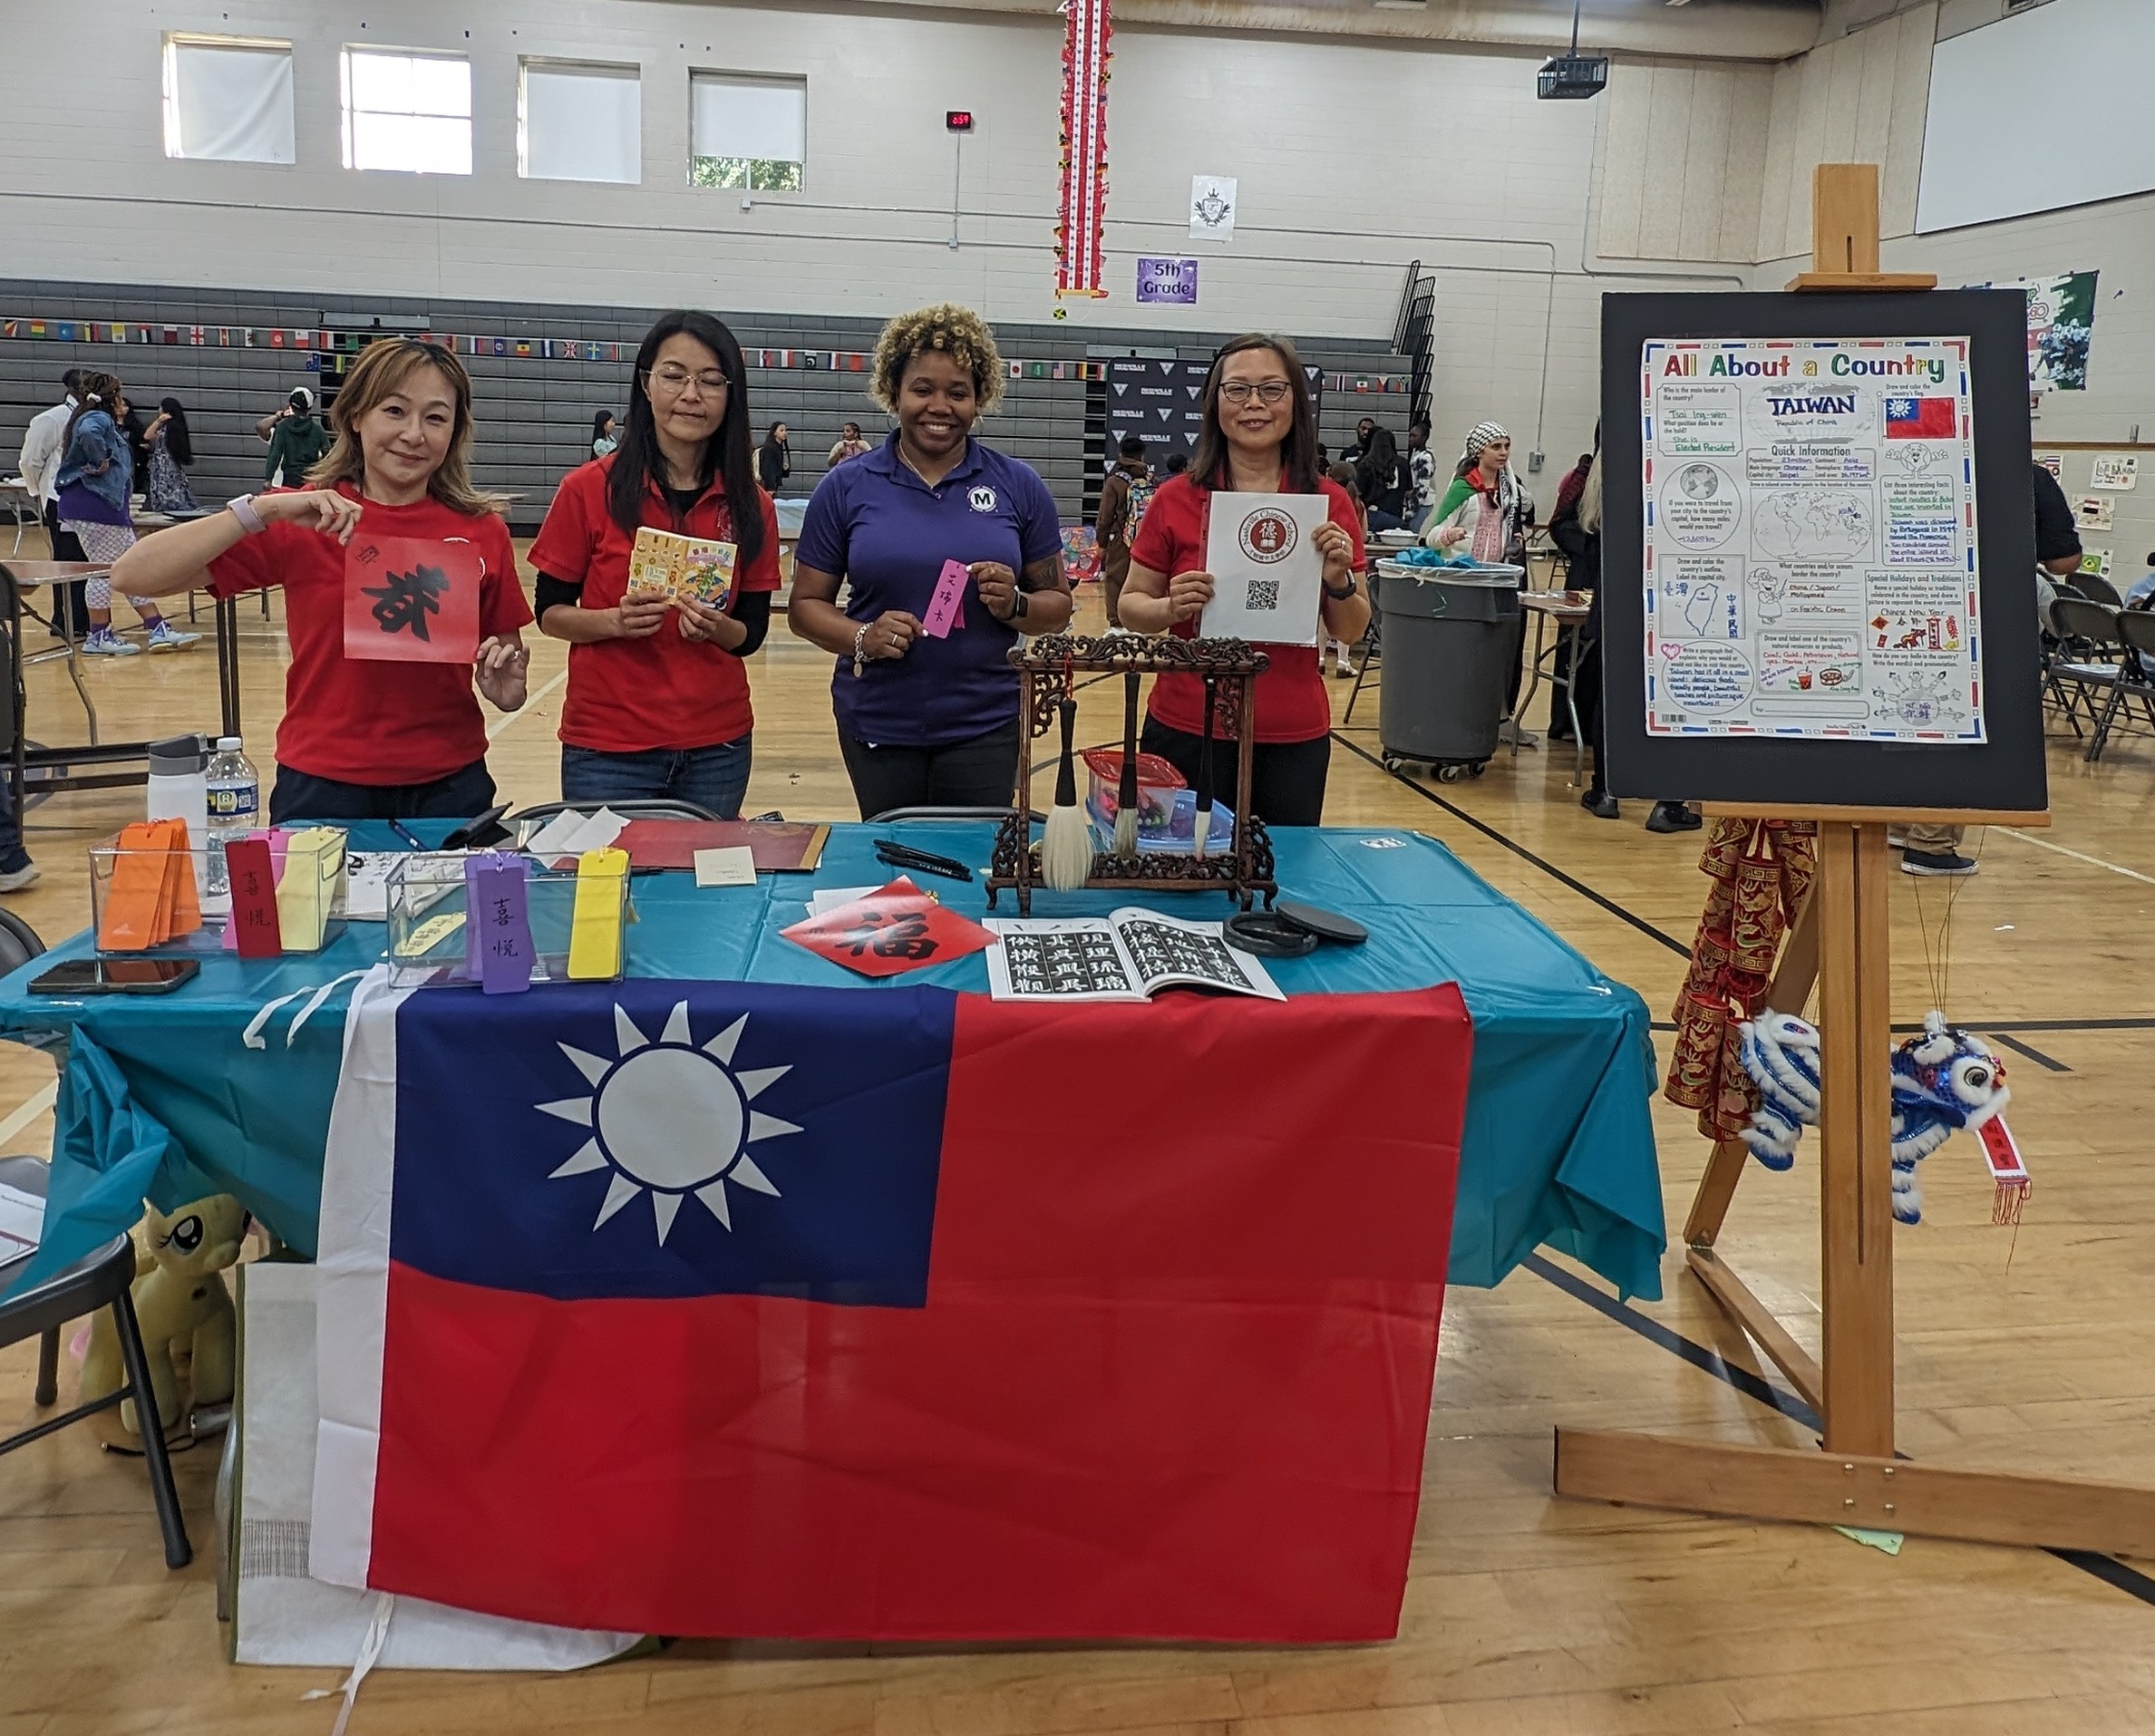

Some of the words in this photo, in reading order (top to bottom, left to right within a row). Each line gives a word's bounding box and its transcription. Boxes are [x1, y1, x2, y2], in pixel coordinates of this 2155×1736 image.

[1155, 264, 1179, 277] 5th
[1144, 281, 1189, 295] Grade
[1664, 354, 1697, 376] All
[1709, 354, 1791, 376] About
[1802, 360, 1818, 376] a
[1831, 354, 1945, 383] Country
[1766, 395, 1855, 416] TAIWAN
[1772, 445, 1796, 456] Quick
[1799, 445, 1850, 456] Information
[974, 493, 991, 505] M
[1259, 519, 1277, 539] 德
[1868, 574, 1888, 583] Special
[834, 911, 939, 961] 福
